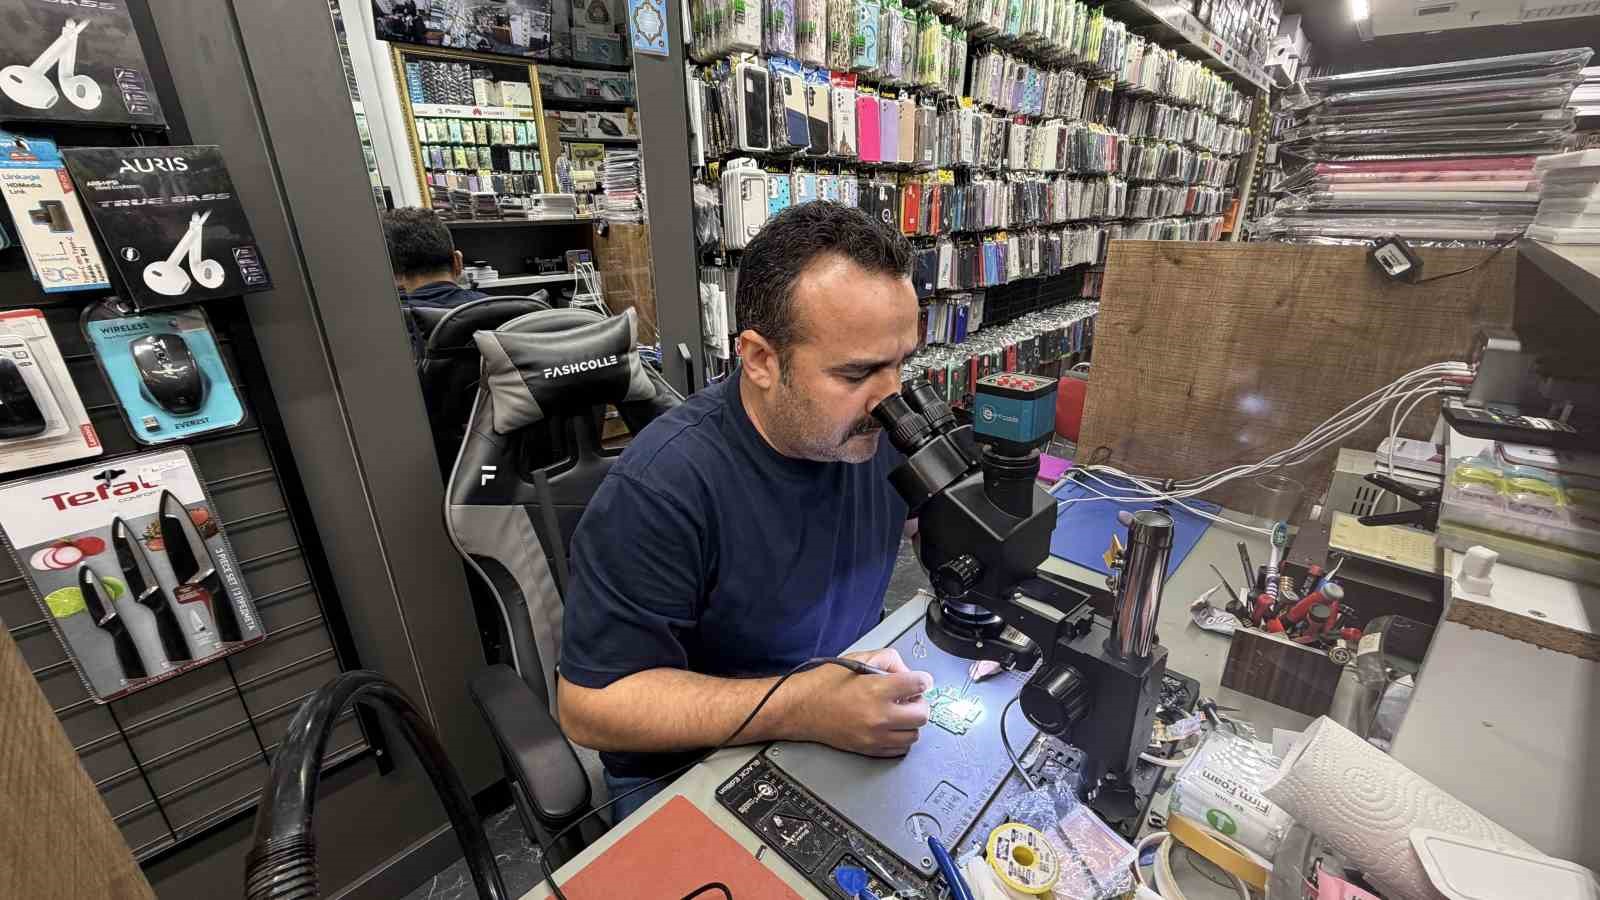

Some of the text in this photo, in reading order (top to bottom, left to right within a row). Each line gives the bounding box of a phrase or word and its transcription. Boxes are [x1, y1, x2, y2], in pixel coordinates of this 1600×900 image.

[119, 156, 189, 174] AURIS
[97, 193, 231, 208] TRUE BASS
[100, 322, 150, 334] WIRELESS
[543, 354, 618, 380] FASHCOLLE
[174, 416, 210, 431] EVEREST
[41, 474, 160, 512] Tefal
[226, 573, 239, 586] SET
[739, 759, 761, 779] BLACK
[1202, 769, 1238, 796] Foam
[1239, 791, 1270, 814] Firm
